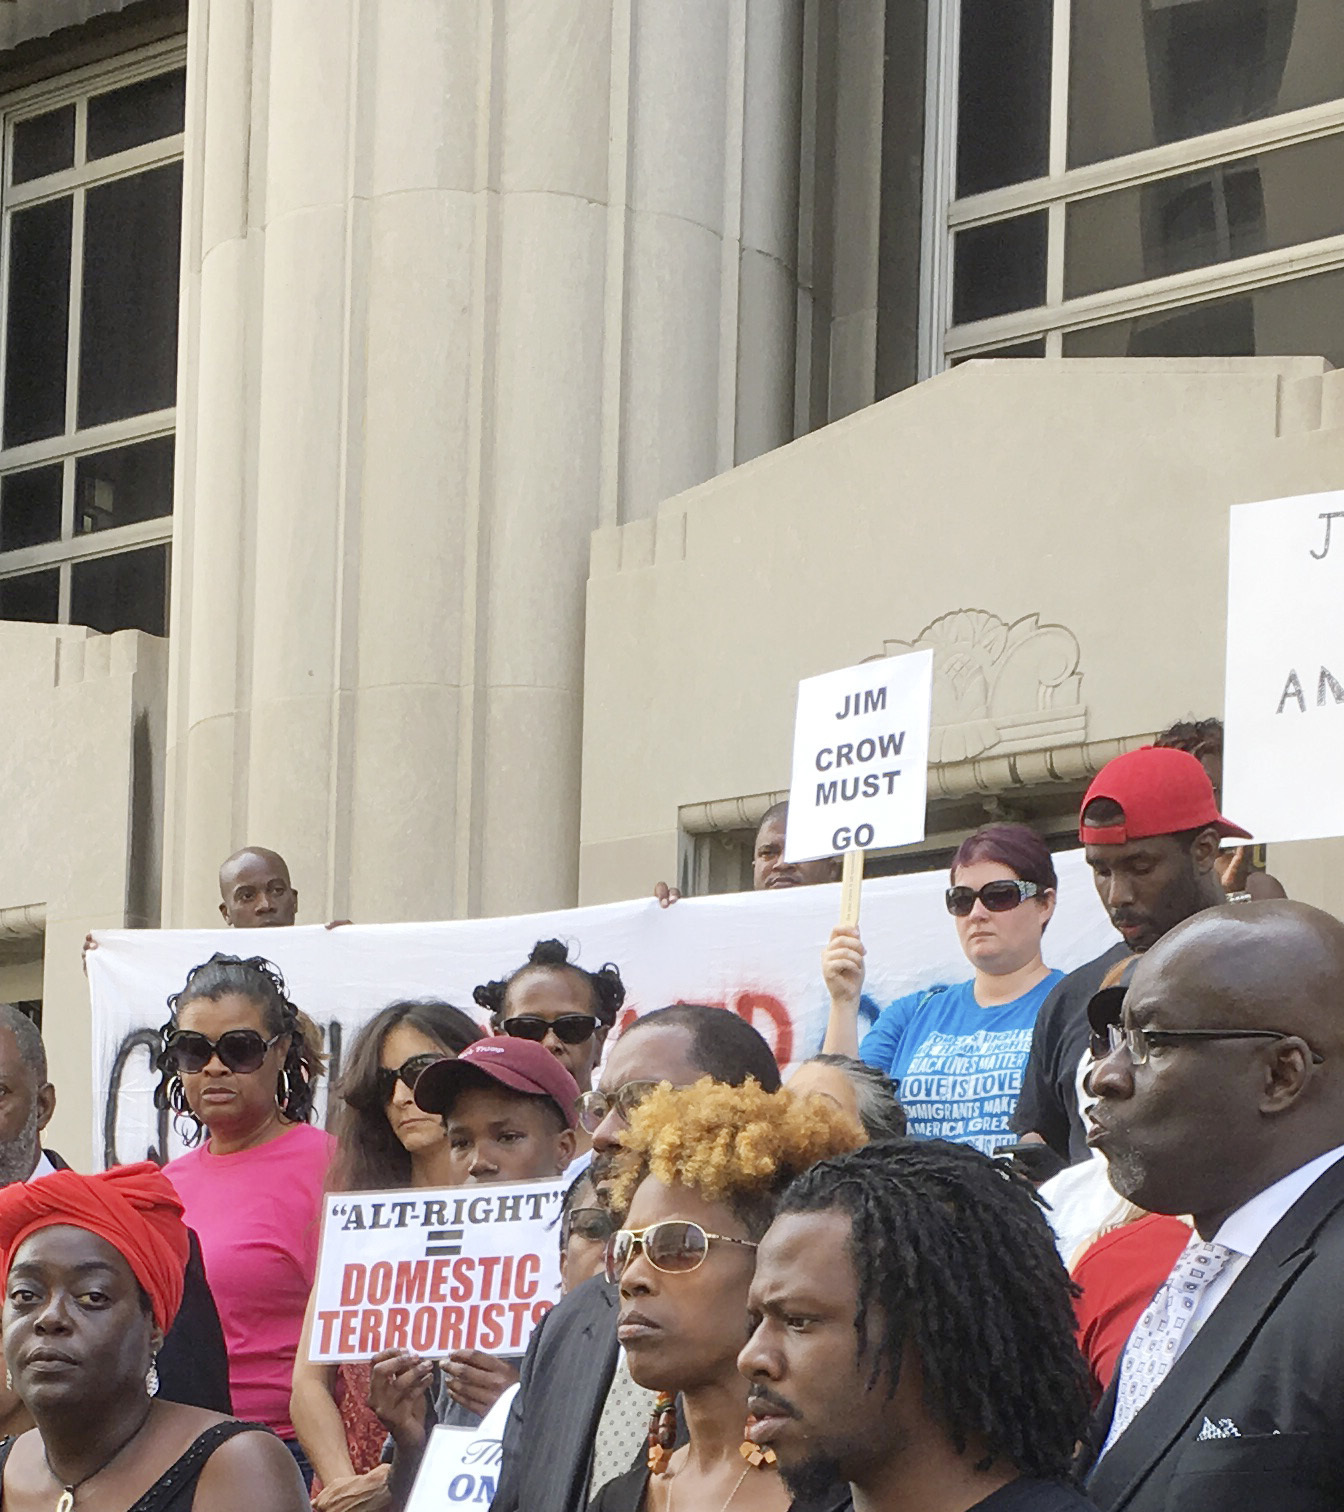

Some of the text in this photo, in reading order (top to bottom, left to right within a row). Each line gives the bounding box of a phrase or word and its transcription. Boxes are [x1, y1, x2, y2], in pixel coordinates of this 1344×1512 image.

[835, 686, 888, 720] JIM
[815, 731, 906, 772] CROW
[815, 770, 902, 806] MUST
[832, 823, 875, 850] GO
[906, 1053, 1027, 1074] BLACK LIVES MATTER
[902, 1071, 1020, 1099] LOVE IS LOVE
[982, 1096, 1018, 1115] MAKE
[905, 1116, 1010, 1136] AMERICA GREA
[339, 1252, 541, 1307] DOMESTIC
